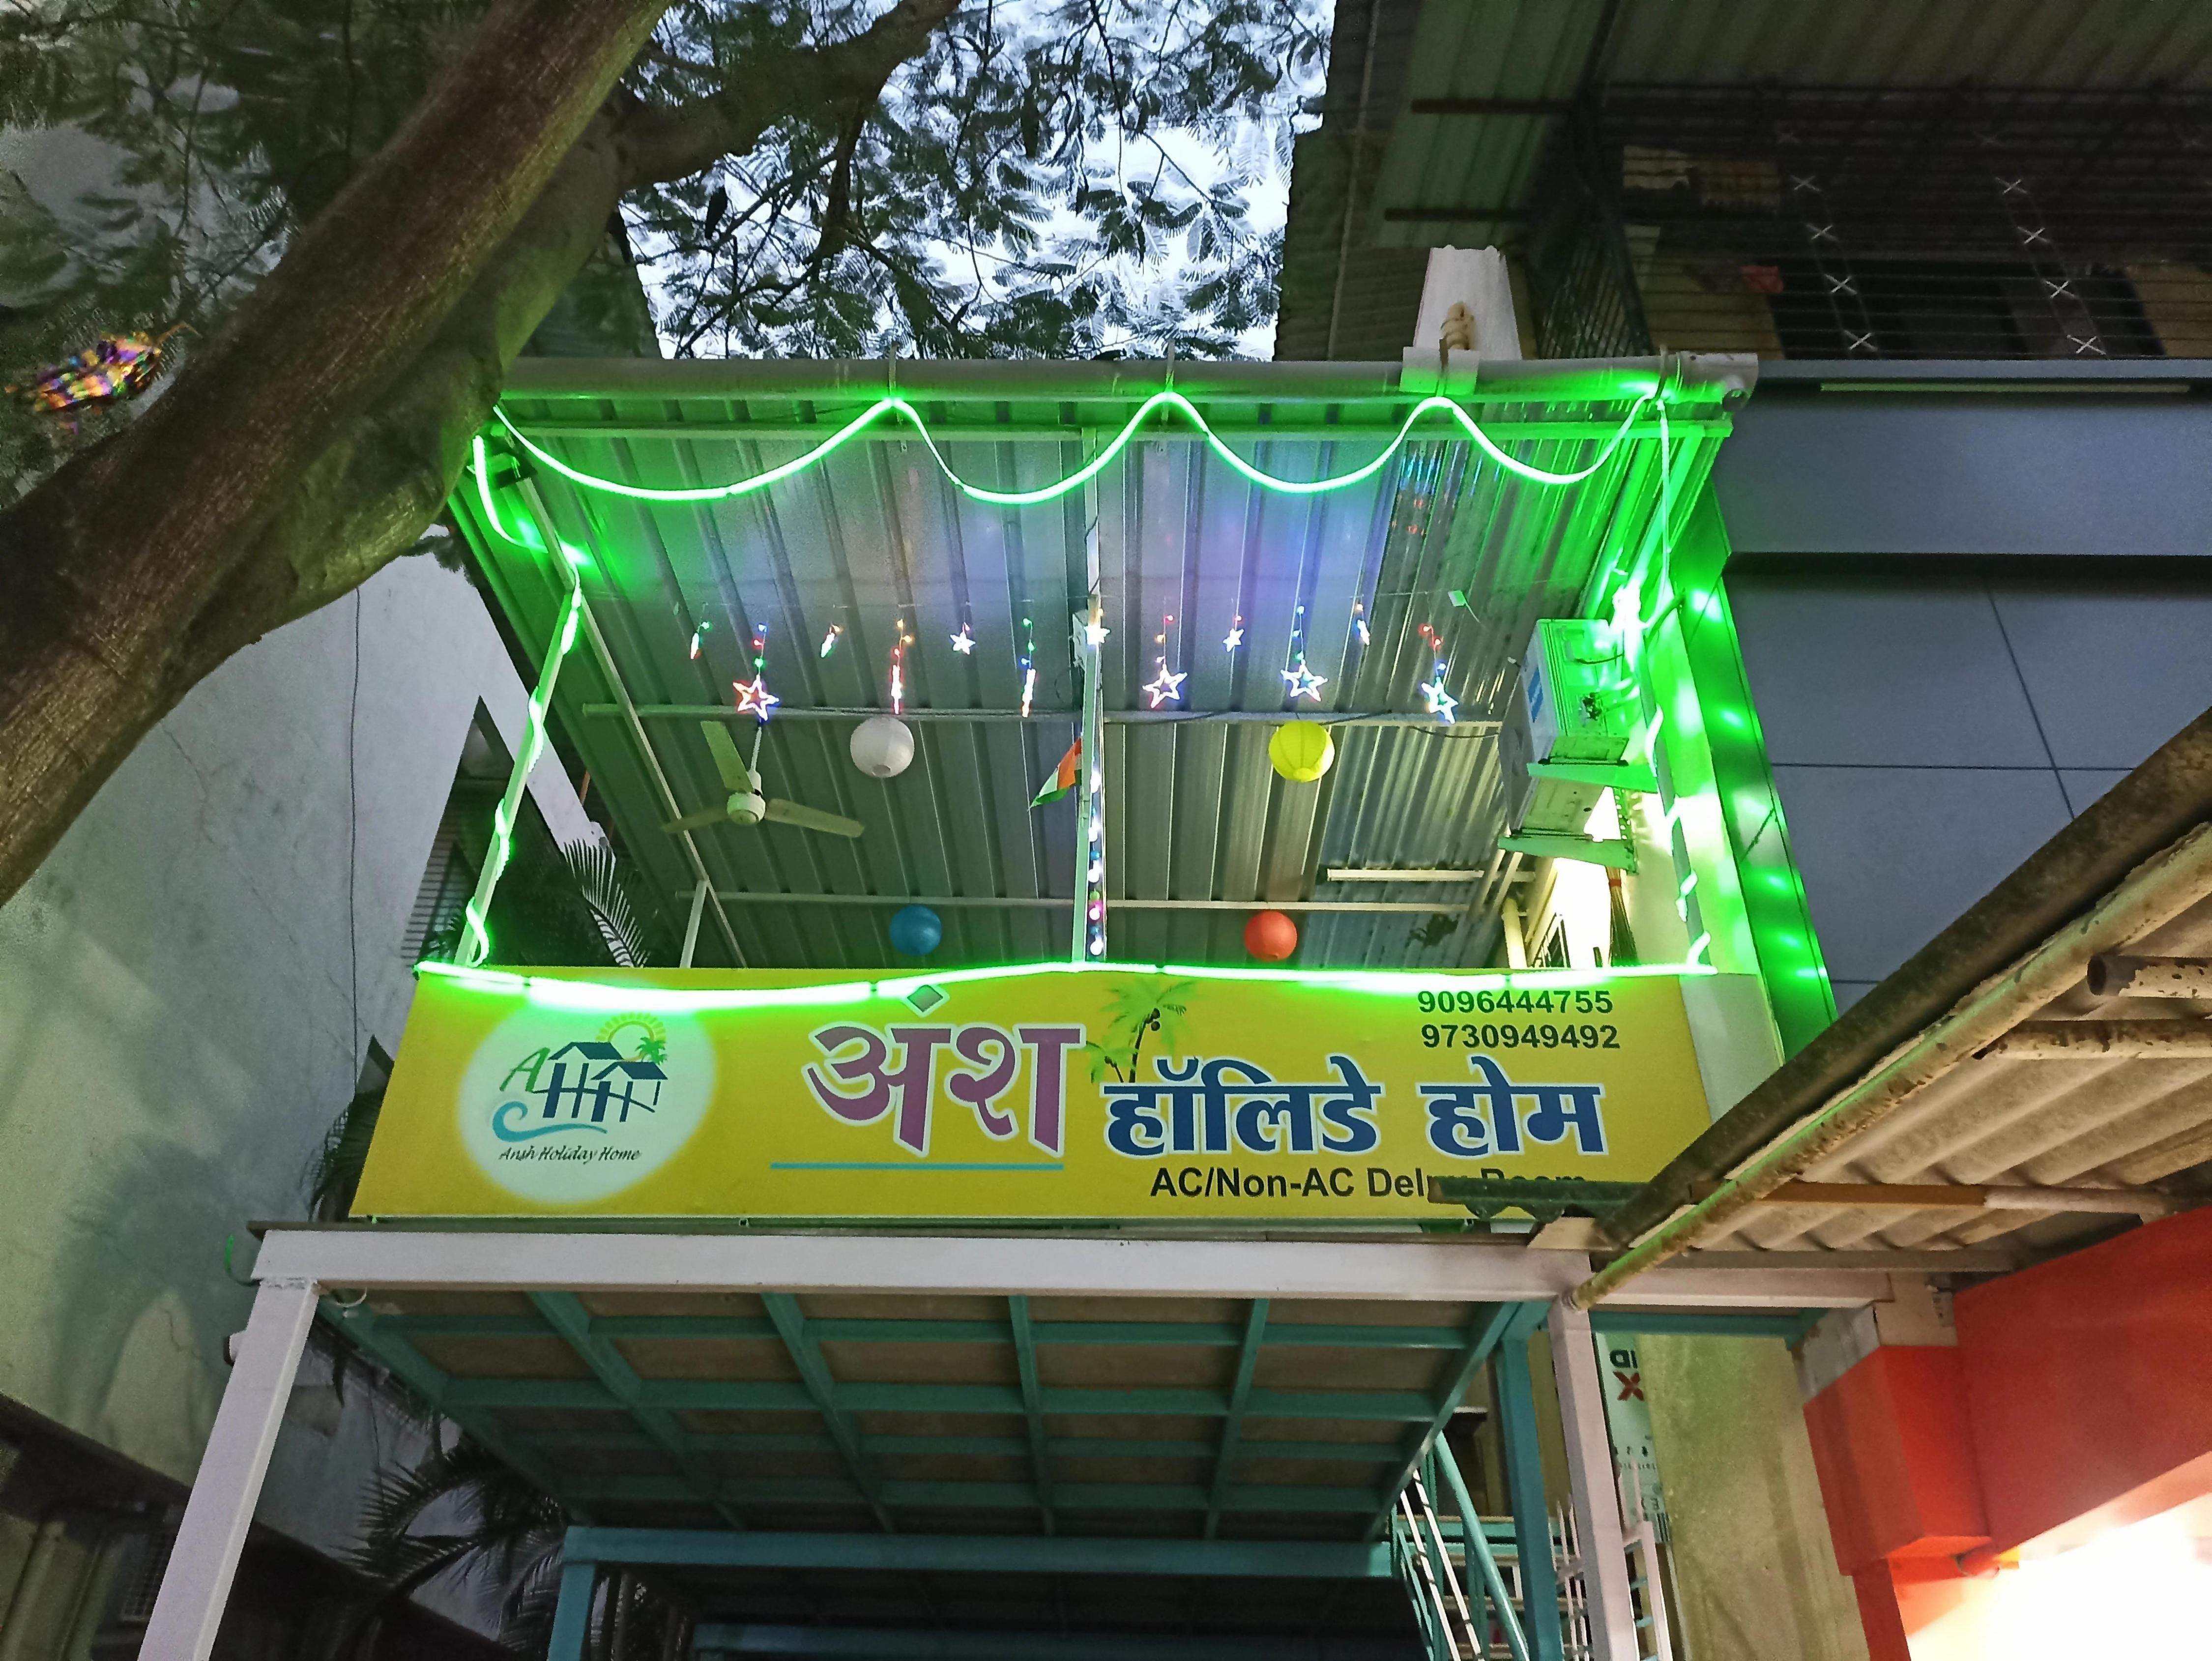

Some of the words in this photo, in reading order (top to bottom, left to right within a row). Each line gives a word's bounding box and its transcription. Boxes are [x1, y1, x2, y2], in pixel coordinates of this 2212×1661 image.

[1418, 990, 1613, 1014] 9096444755
[1421, 1024, 1620, 1048] 9730949492
[806, 985, 1081, 1152] अंश
[1103, 1056, 1382, 1156] हॉलिडे
[1420, 1055, 1605, 1156] होम
[498, 1145, 536, 1161] Ansh
[538, 1145, 598, 1165] Holiday
[598, 1145, 641, 1161] Home
[1150, 1167, 1355, 1197] AC/Non-AC
